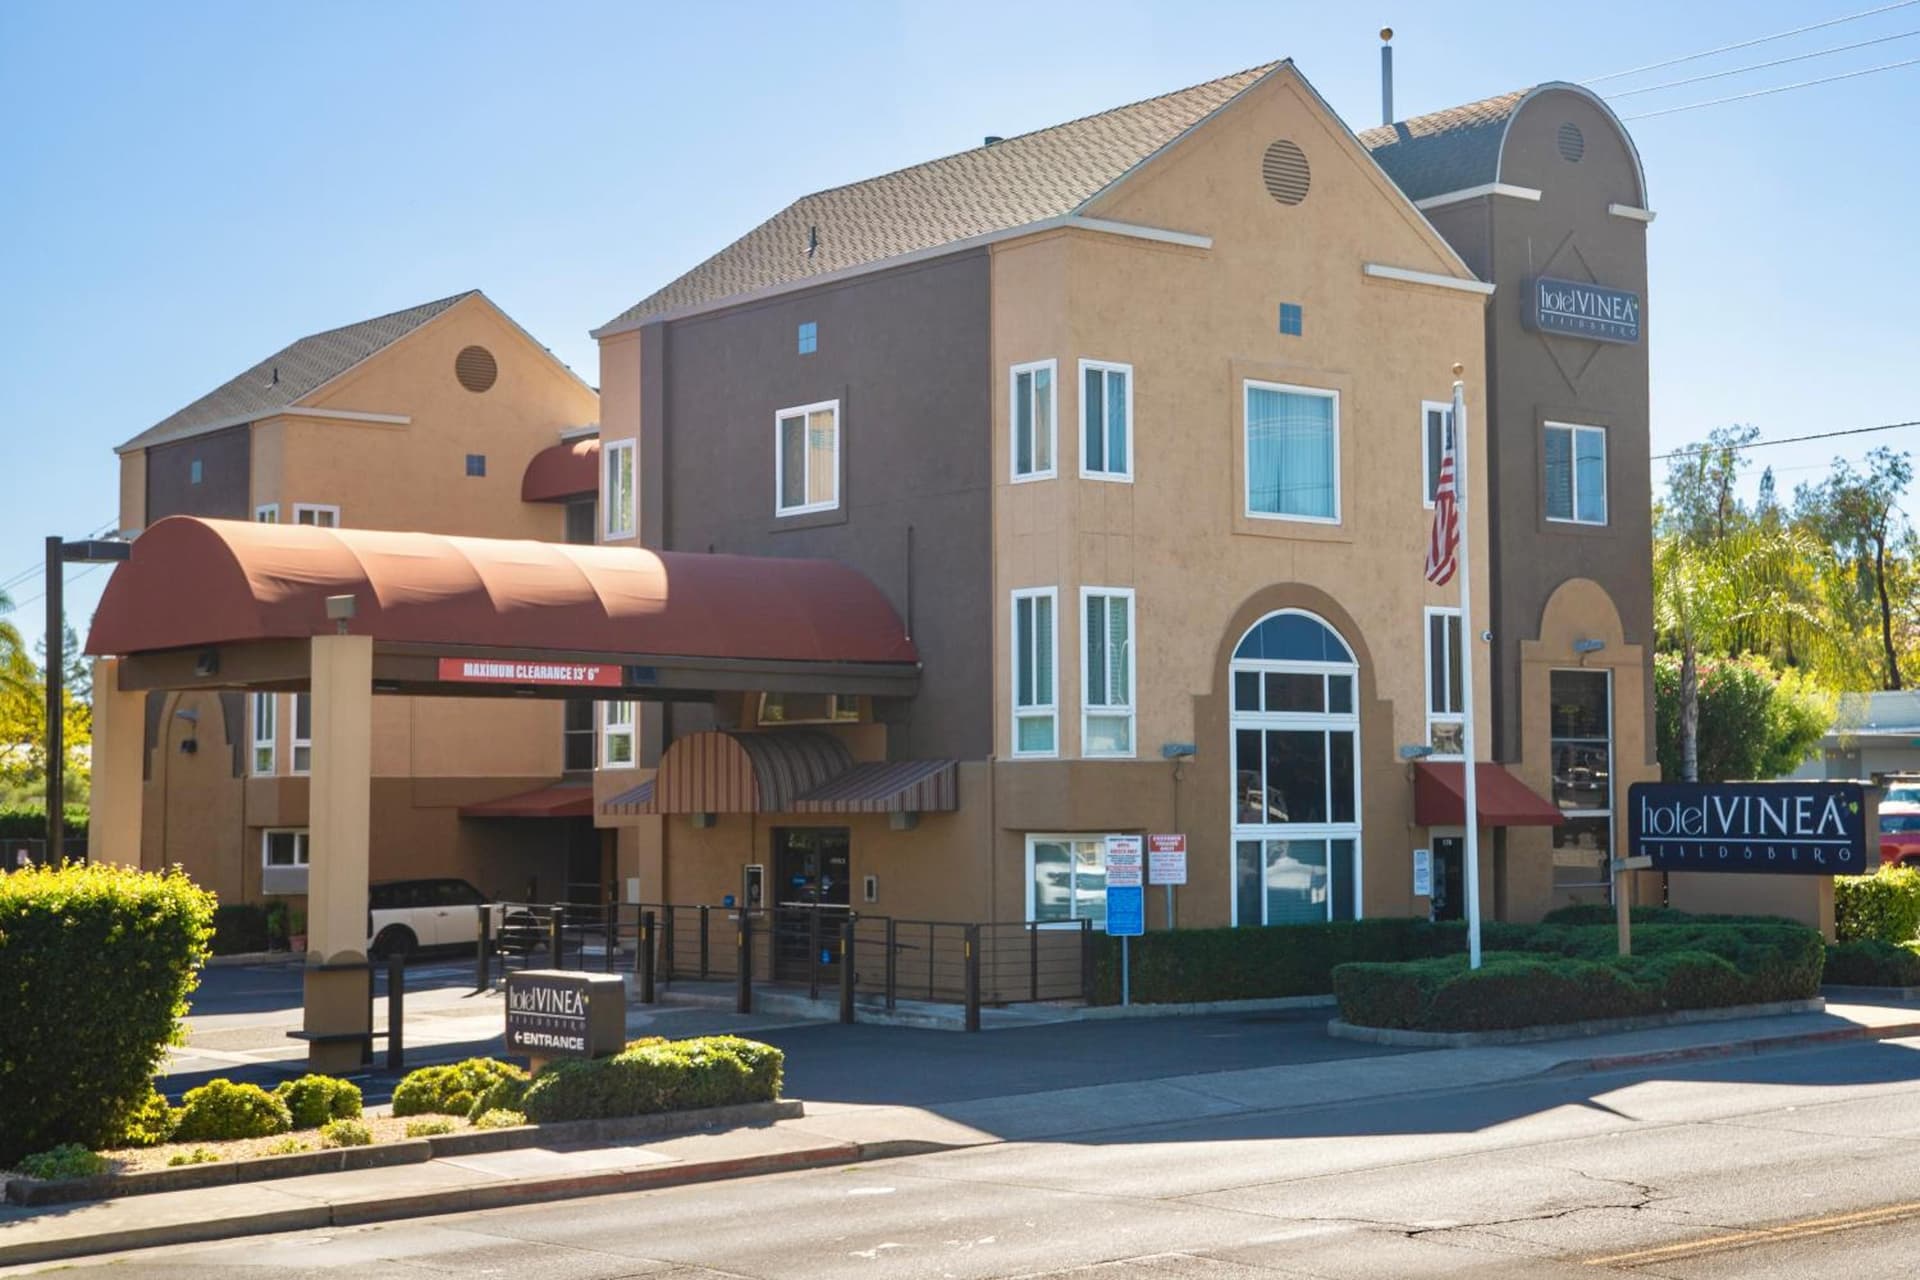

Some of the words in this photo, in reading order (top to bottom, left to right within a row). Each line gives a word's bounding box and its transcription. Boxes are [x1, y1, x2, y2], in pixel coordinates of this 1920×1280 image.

[463, 662, 514, 678] MAXIMUM
[516, 665, 572, 681] CLEARANCE
[523, 1032, 585, 1051] ENTRANCE
